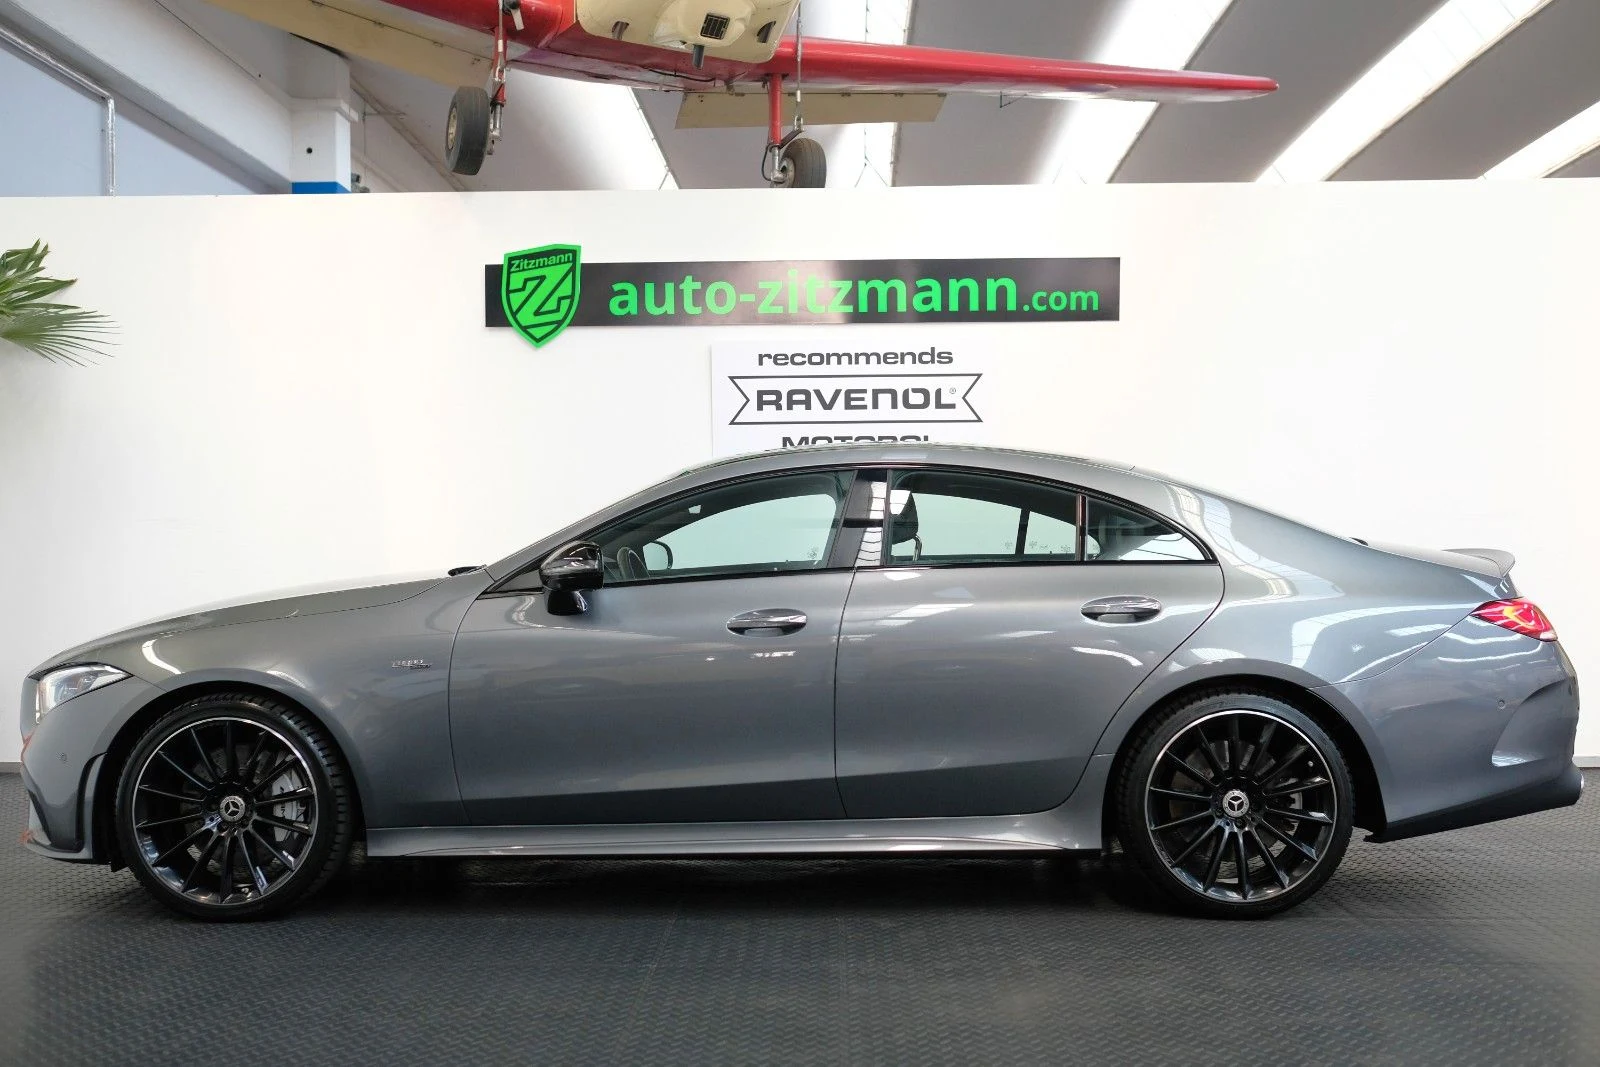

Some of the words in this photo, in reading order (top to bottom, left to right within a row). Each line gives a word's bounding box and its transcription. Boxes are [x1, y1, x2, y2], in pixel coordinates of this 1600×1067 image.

[510, 252, 573, 272] Zitzmann
[608, 268, 1099, 316] auto-zitzmann.com
[758, 347, 954, 366] recommends
[756, 387, 957, 412] RAVENOL
